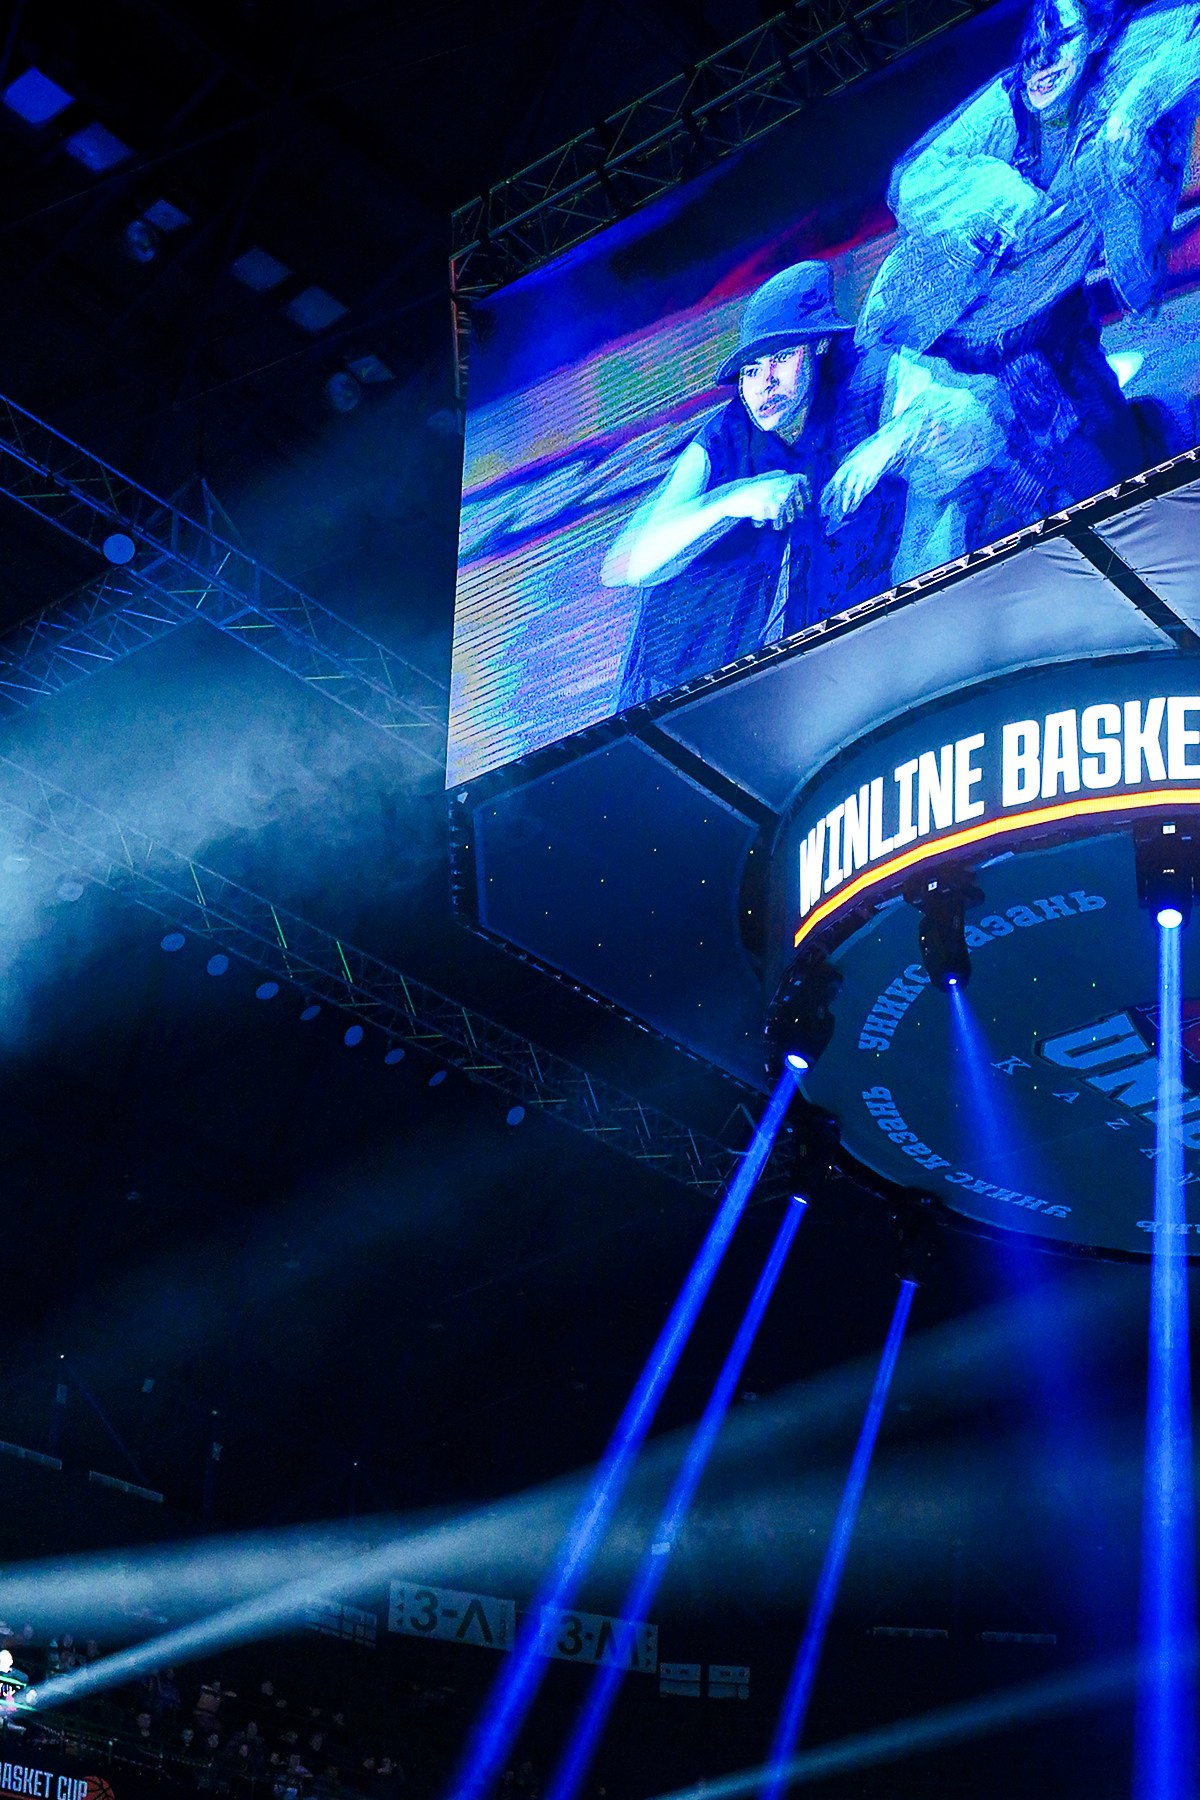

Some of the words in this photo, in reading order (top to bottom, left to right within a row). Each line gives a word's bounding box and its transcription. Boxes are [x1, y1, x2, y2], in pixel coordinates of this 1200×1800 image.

[799, 732, 985, 918] WINLINE
[963, 889, 1107, 953] азань
[0, 1762, 53, 1799] ASKET
